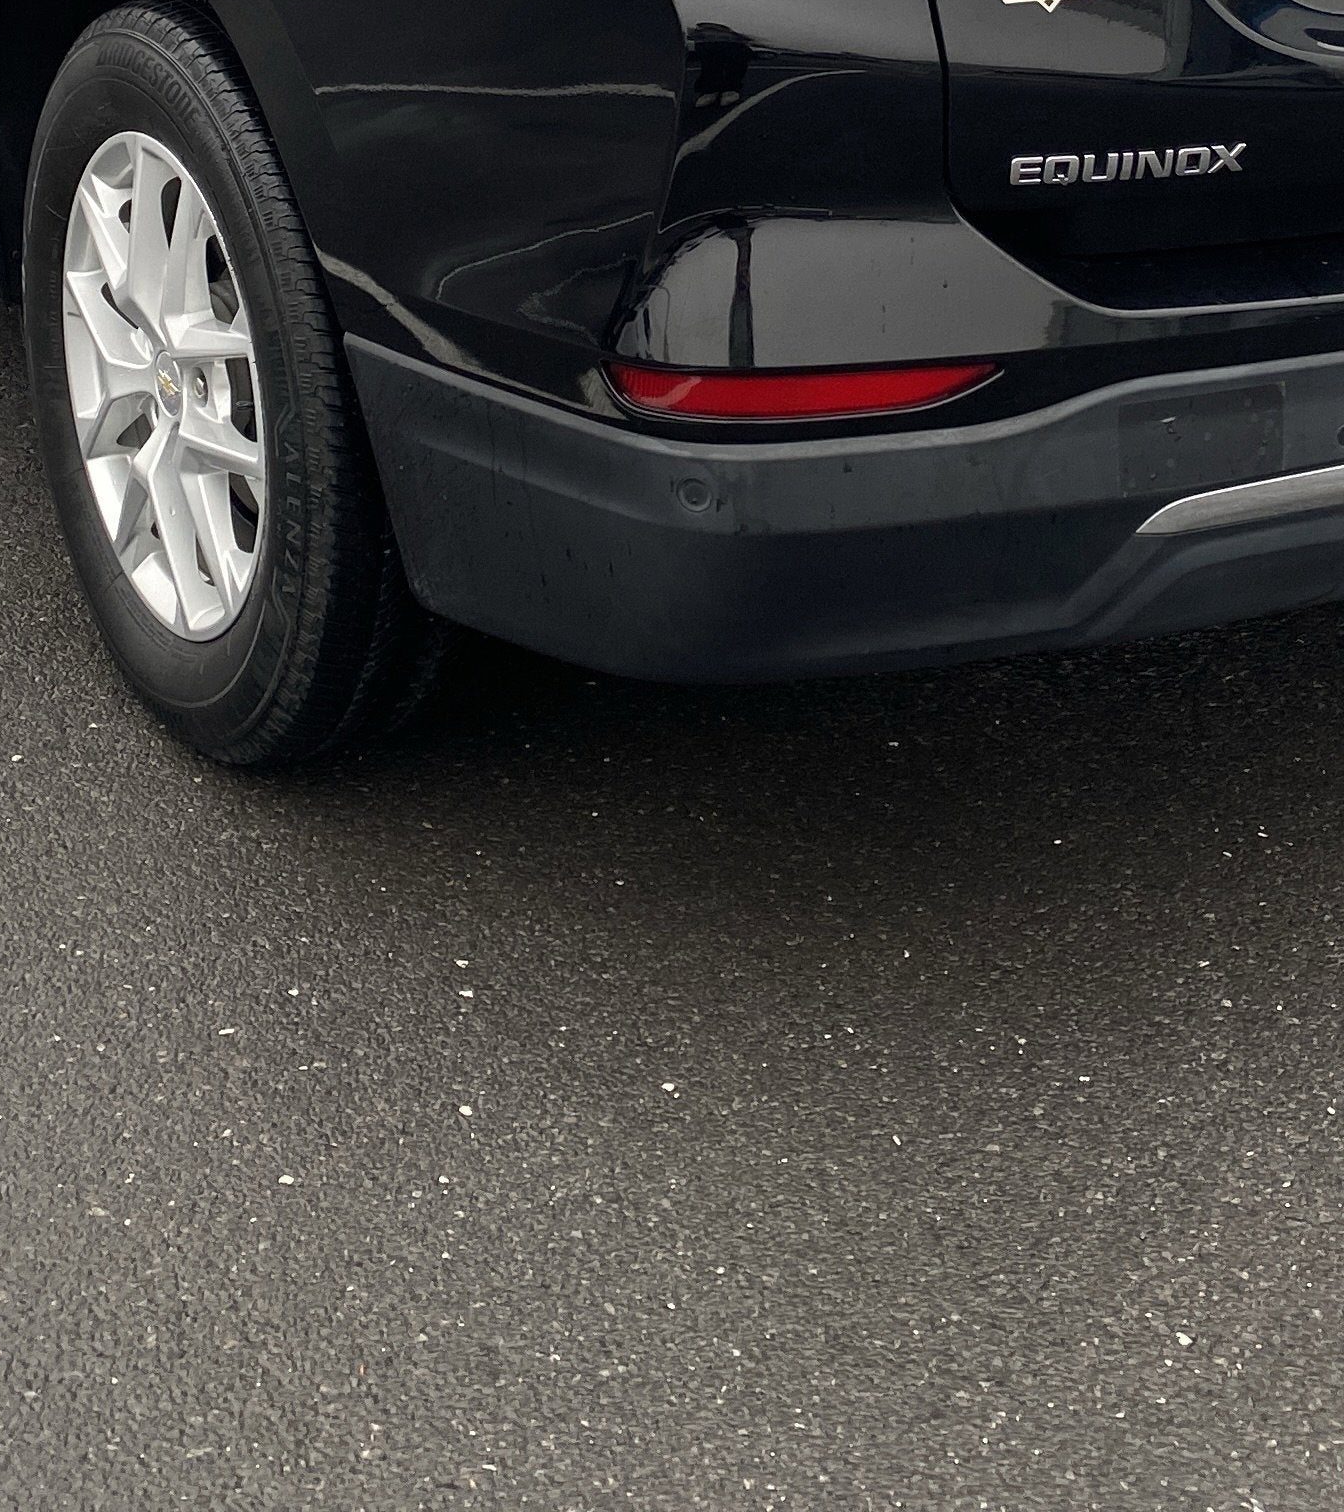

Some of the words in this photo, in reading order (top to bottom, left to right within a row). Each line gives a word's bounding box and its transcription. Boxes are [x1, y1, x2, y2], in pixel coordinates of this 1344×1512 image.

[95, 41, 200, 133] BRIDGESTONE
[1009, 143, 1247, 186] EQUINOX
[282, 441, 302, 593] ALENZA
